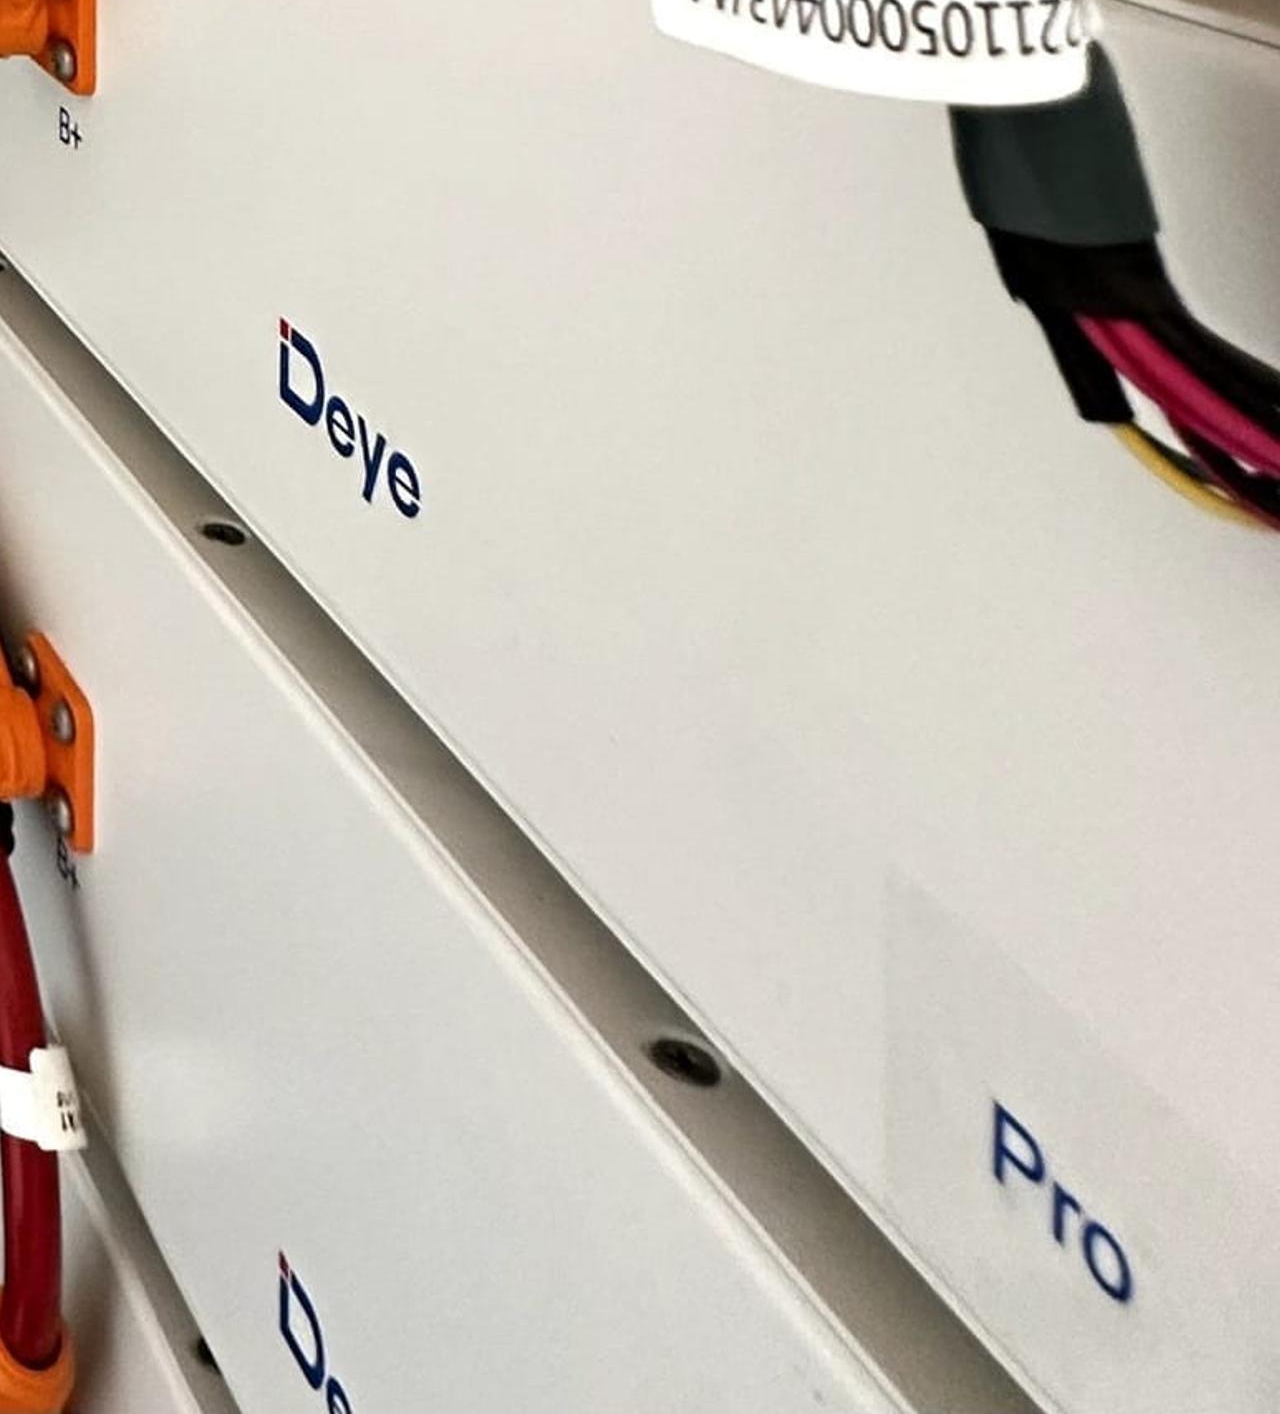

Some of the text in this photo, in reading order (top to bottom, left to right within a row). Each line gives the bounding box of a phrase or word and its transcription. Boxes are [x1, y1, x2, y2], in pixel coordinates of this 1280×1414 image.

[58, 107, 83, 150] B+
[278, 317, 422, 520] Deye
[991, 1098, 1134, 1306] Pro
